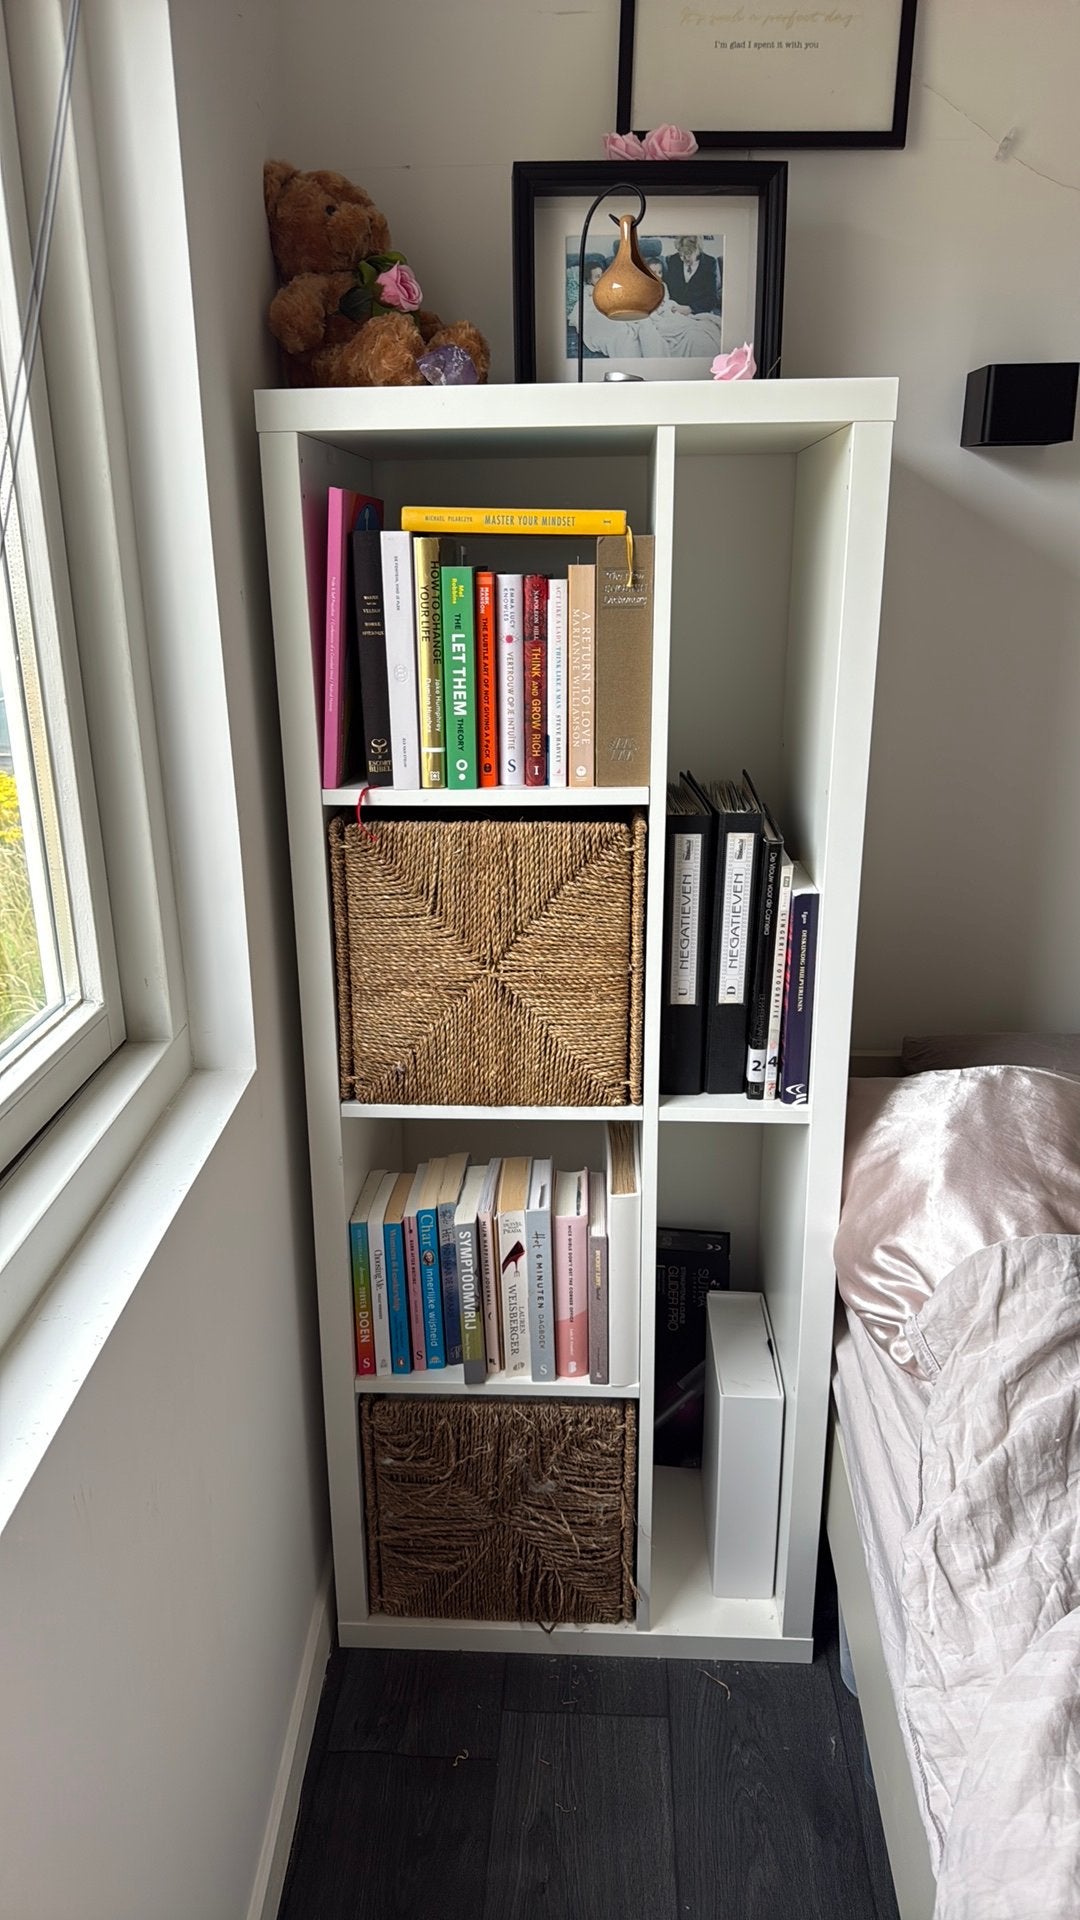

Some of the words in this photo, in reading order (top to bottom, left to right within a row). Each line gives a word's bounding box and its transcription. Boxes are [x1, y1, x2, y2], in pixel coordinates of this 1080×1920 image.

[761, 9, 823, 31] perfect
[824, 8, 857, 28] day
[714, 40, 728, 49] I'm
[729, 40, 746, 50] glad
[753, 40, 775, 50] spent
[785, 40, 803, 49] with
[804, 41, 819, 50] you
[424, 514, 445, 522] MICHAEL
[484, 514, 515, 526] MASTER
[517, 515, 539, 526] YOUR
[541, 515, 576, 527] MINDSET
[430, 560, 441, 592] HOW
[420, 585, 430, 618] YOUR
[431, 593, 441, 610] TO
[582, 611, 591, 620] A
[421, 620, 431, 643] LIFE
[454, 613, 462, 630] THE
[431, 613, 443, 665] CHANGE
[451, 633, 466, 664] LET
[572, 608, 580, 671] MARIANNE
[582, 626, 592, 681] RETURN
[506, 651, 515, 695] VERTROUW
[531, 647, 542, 677] THINK
[452, 666, 467, 716] THEM
[483, 679, 489, 689] OF
[531, 681, 539, 696] AND
[581, 686, 591, 705] TO
[435, 696, 443, 733] Humphrey
[507, 696, 515, 708] OP
[531, 698, 542, 730] GROW
[572, 675, 580, 747] WILLIAMSON
[457, 718, 465, 752] THEORY
[581, 710, 591, 745] LOVE
[532, 733, 542, 757] RICH
[507, 758, 516, 773] S
[768, 863, 776, 883] Vrouw
[769, 852, 778, 863] De
[765, 899, 773, 909] de
[679, 874, 692, 970] NEGATIEVEN
[728, 873, 744, 969] NEGATIEVEN
[763, 908, 773, 936] Camera
[777, 912, 786, 957] LINGERIE
[800, 929, 808, 965] DESKUNDIG
[678, 986, 688, 996] U
[726, 985, 737, 995] D
[773, 963, 784, 1019] FOTOGRAFIE
[390, 1229, 398, 1260] Women
[420, 1214, 434, 1246] Char
[532, 1231, 545, 1249] Het
[374, 1249, 384, 1279] Choosing
[392, 1266, 401, 1312] Leadership
[426, 1268, 436, 1309] innerlijke
[458, 1230, 477, 1330] SYMPTOOMVRIJ
[535, 1262, 545, 1309] MINUTEN
[668, 1265, 680, 1305] GLIDER
[698, 1268, 710, 1307] SUTRA
[359, 1311, 370, 1344] DOEN
[428, 1311, 439, 1347] wijsheid
[508, 1284, 519, 1356] WEISBERGER
[518, 1306, 526, 1335] LAUREN
[537, 1314, 545, 1349] DAGBOEK
[667, 1306, 679, 1331] PRO
[362, 1357, 371, 1369] S
[416, 1350, 424, 1361] S
[540, 1364, 548, 1375] S
